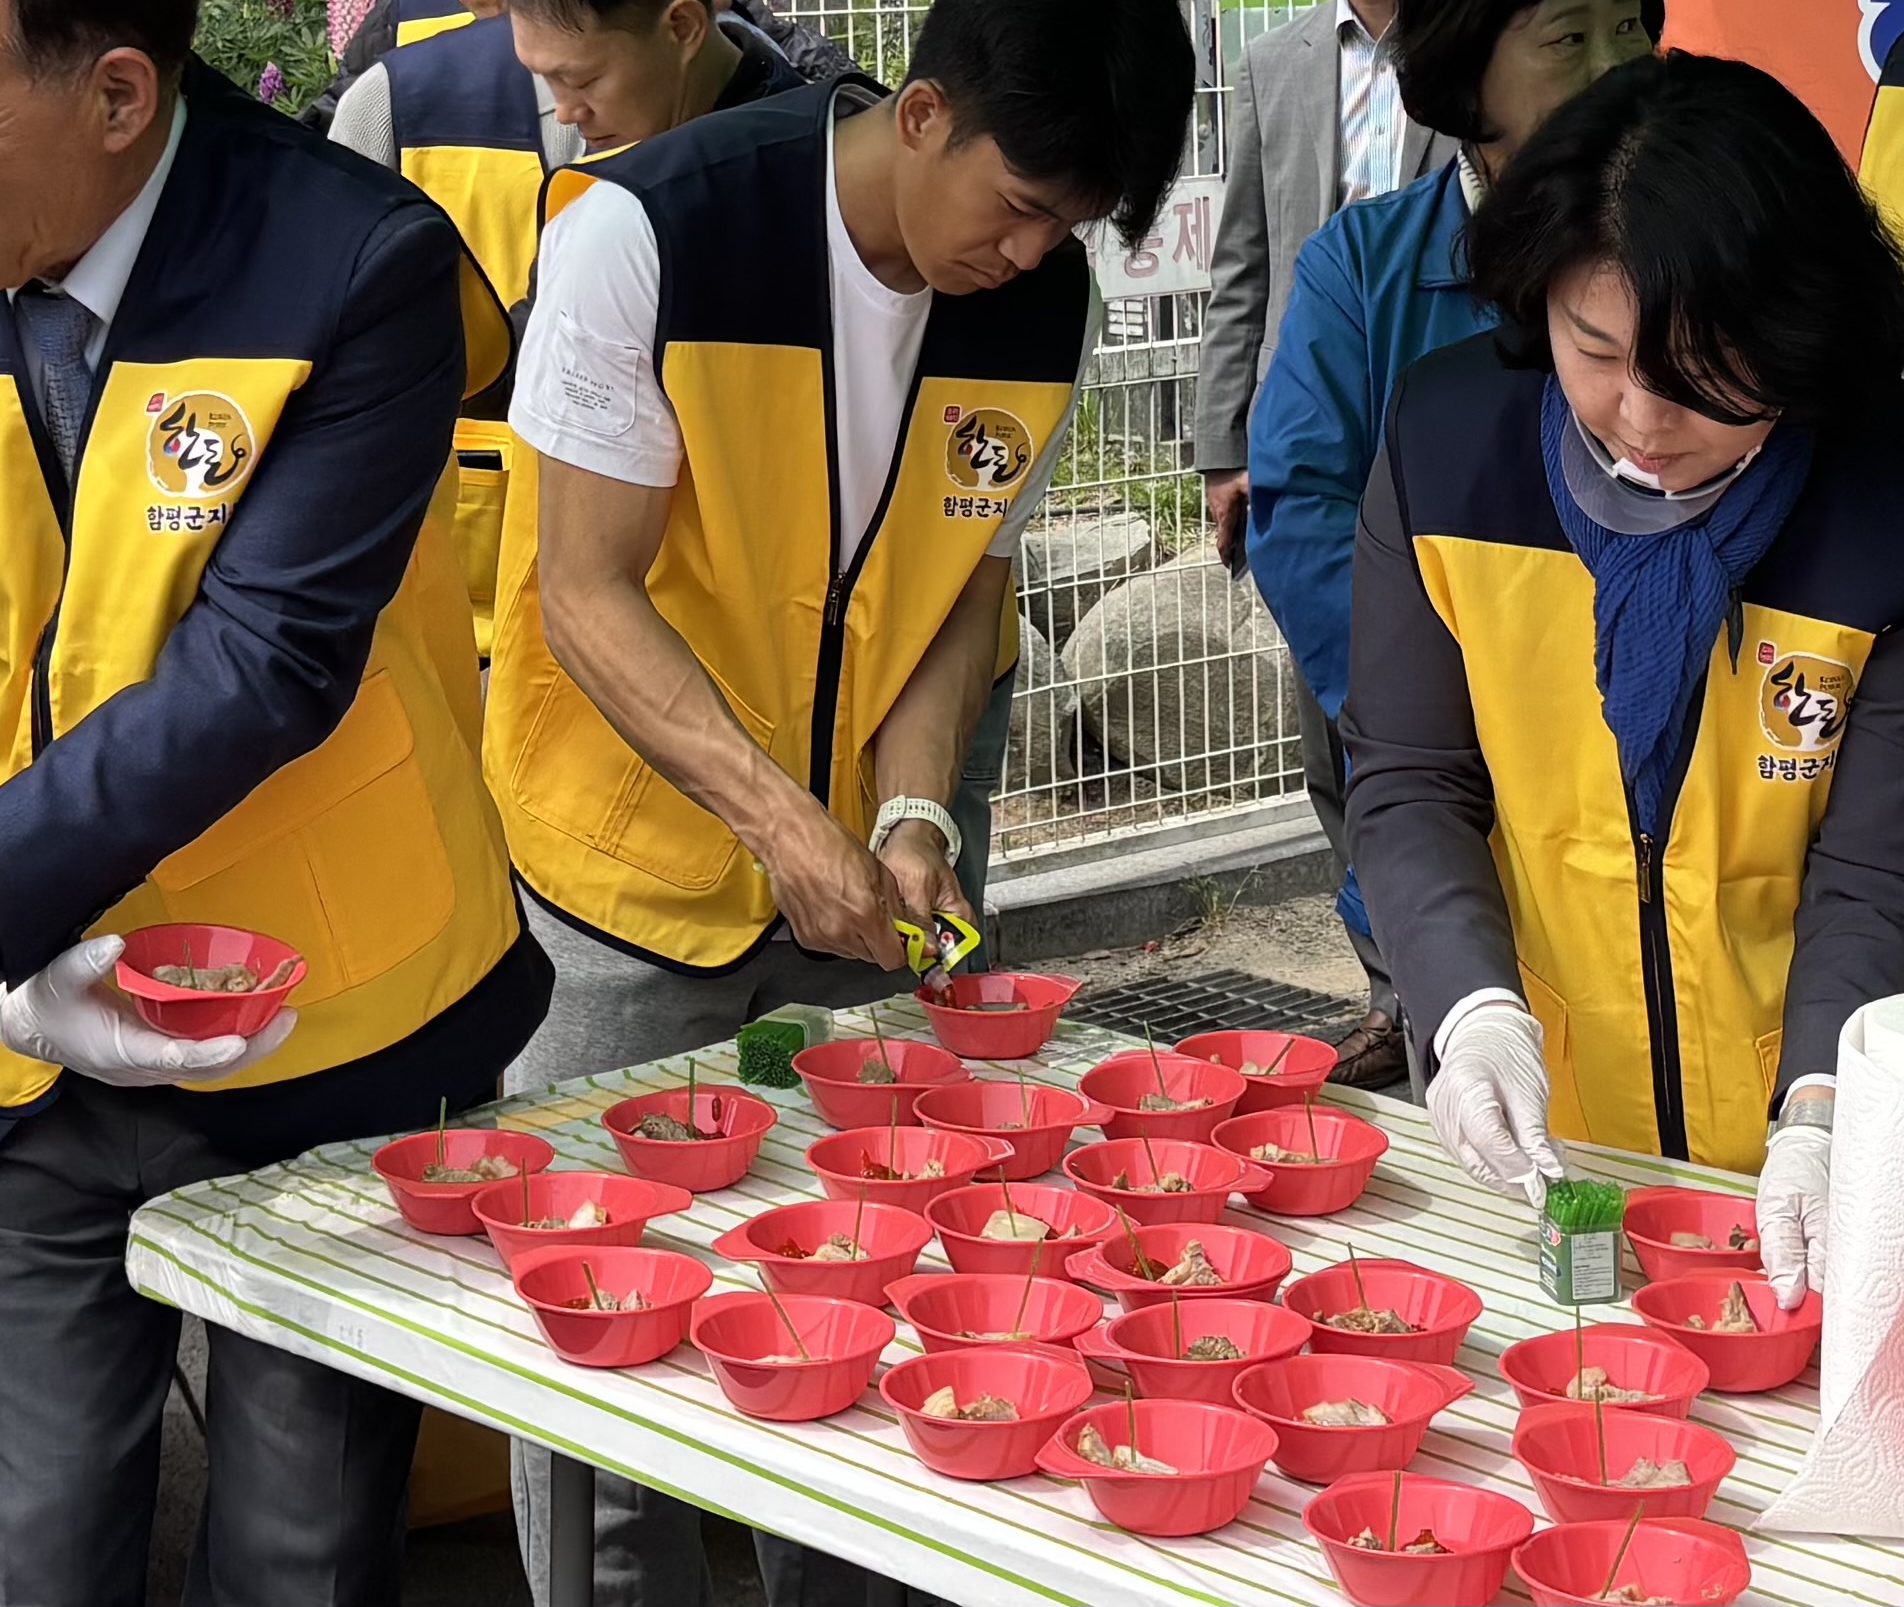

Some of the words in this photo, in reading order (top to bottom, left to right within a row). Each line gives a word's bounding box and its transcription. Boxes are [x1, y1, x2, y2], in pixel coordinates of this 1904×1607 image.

[147, 503, 233, 532] 함평군지
[943, 495, 1011, 518] 함평군지
[1758, 750, 1836, 782] 함평군지
